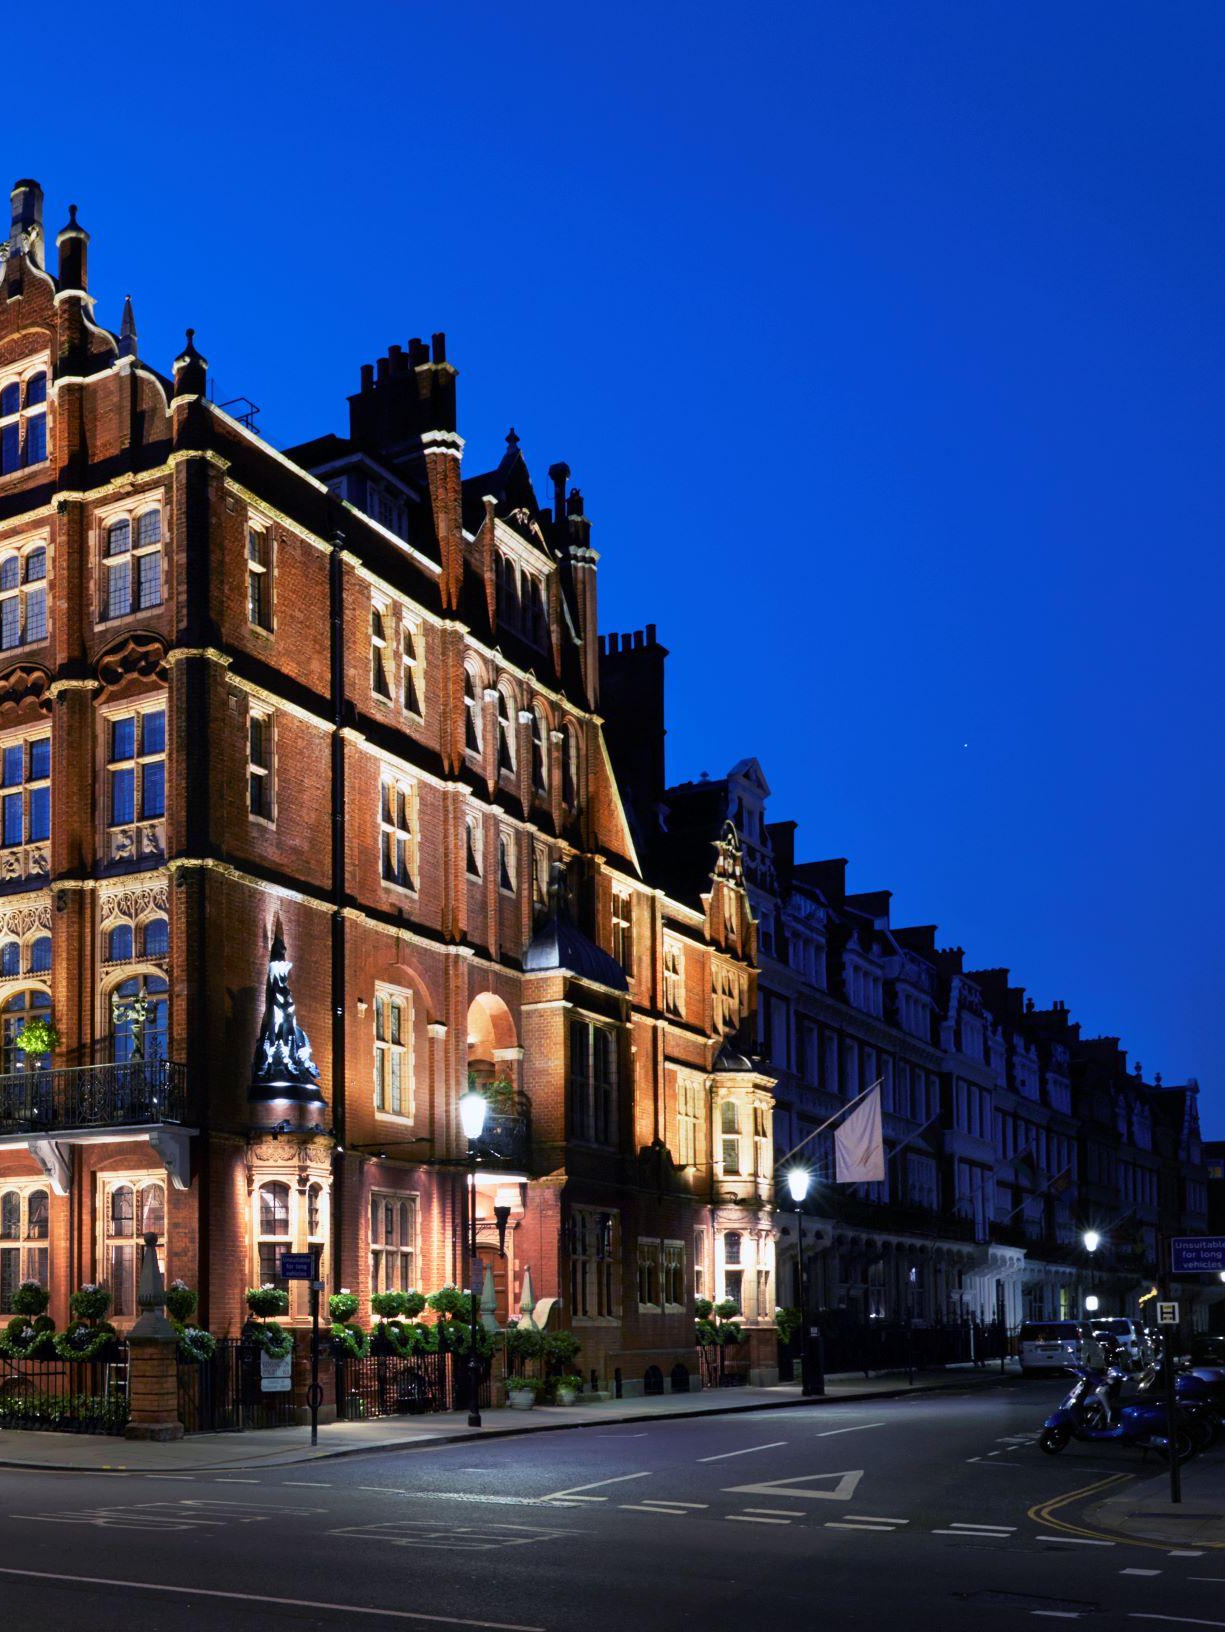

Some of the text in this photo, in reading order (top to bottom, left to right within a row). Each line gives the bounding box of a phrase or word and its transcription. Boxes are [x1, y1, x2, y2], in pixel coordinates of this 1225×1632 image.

[1182, 1250, 1222, 1259] for long
[1183, 1260, 1222, 1268] vehicles
